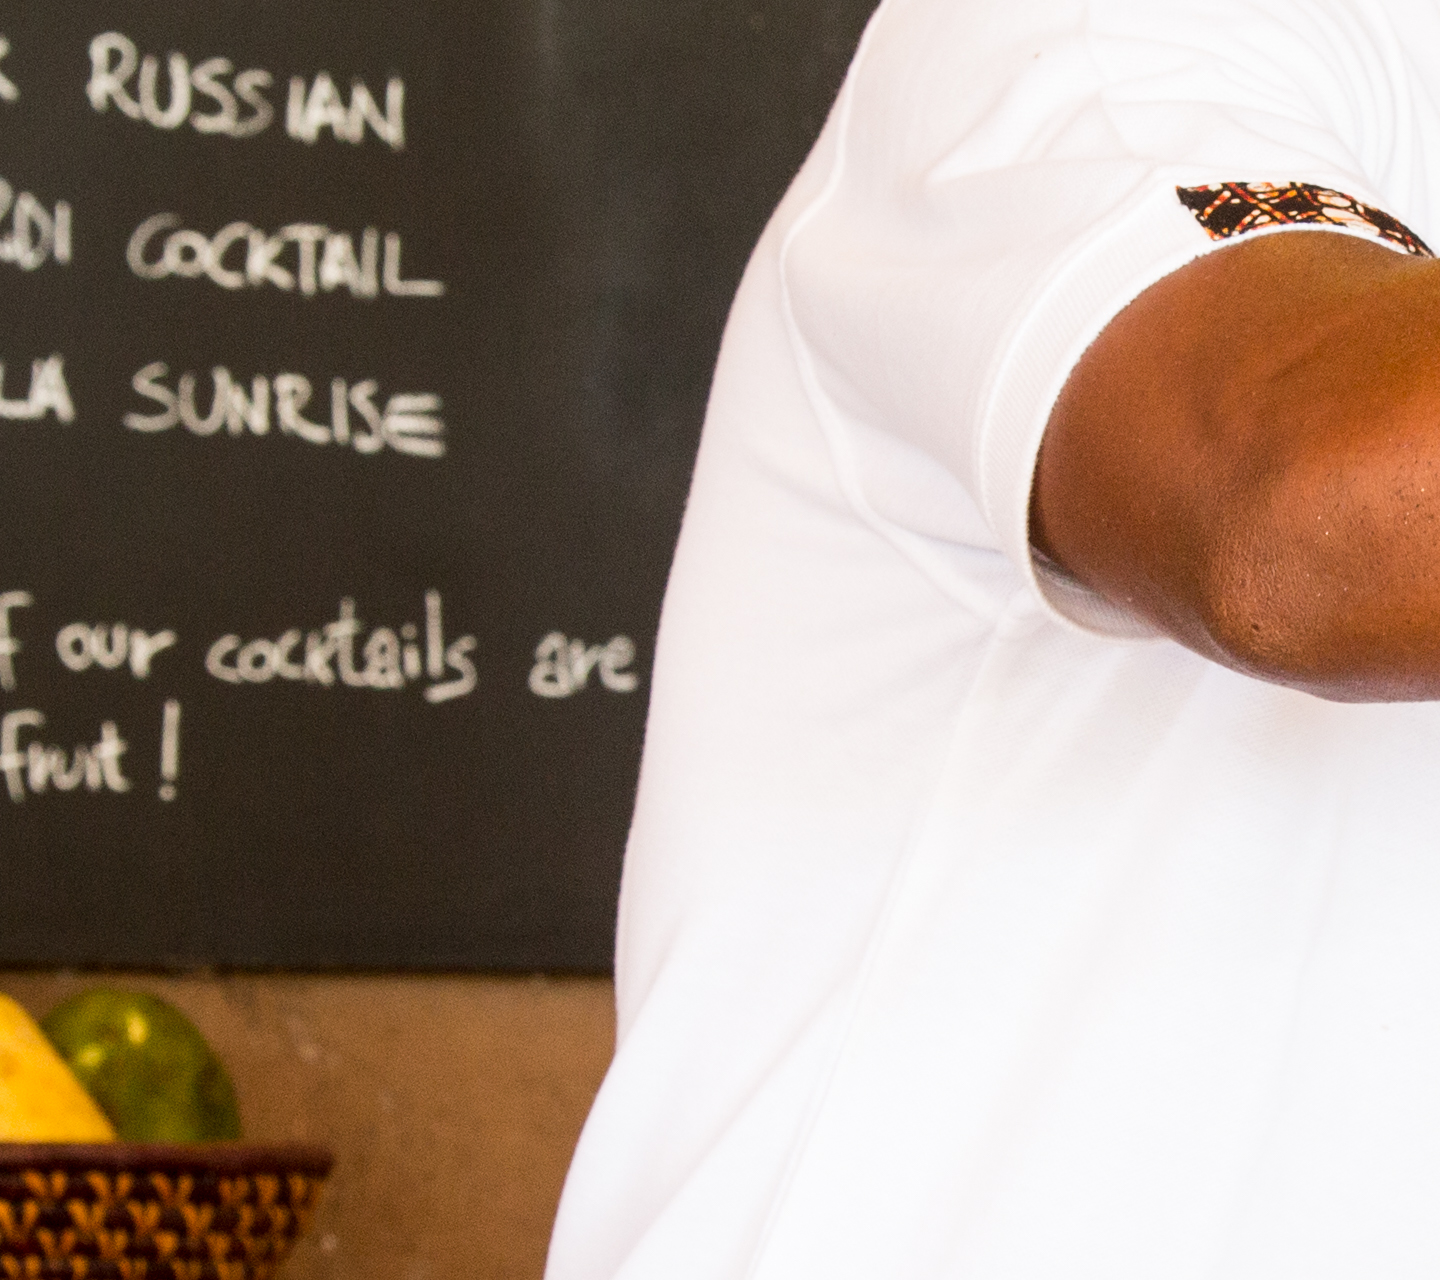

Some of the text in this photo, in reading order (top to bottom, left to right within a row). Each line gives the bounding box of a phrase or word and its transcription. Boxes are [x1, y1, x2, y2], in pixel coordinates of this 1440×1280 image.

[84, 29, 407, 149] RUSSIAN
[126, 217, 443, 298] COCKTAIL
[124, 361, 446, 459] SUNRISE
[54, 621, 177, 679] our
[203, 590, 479, 705] cocktails
[527, 631, 638, 699] are
